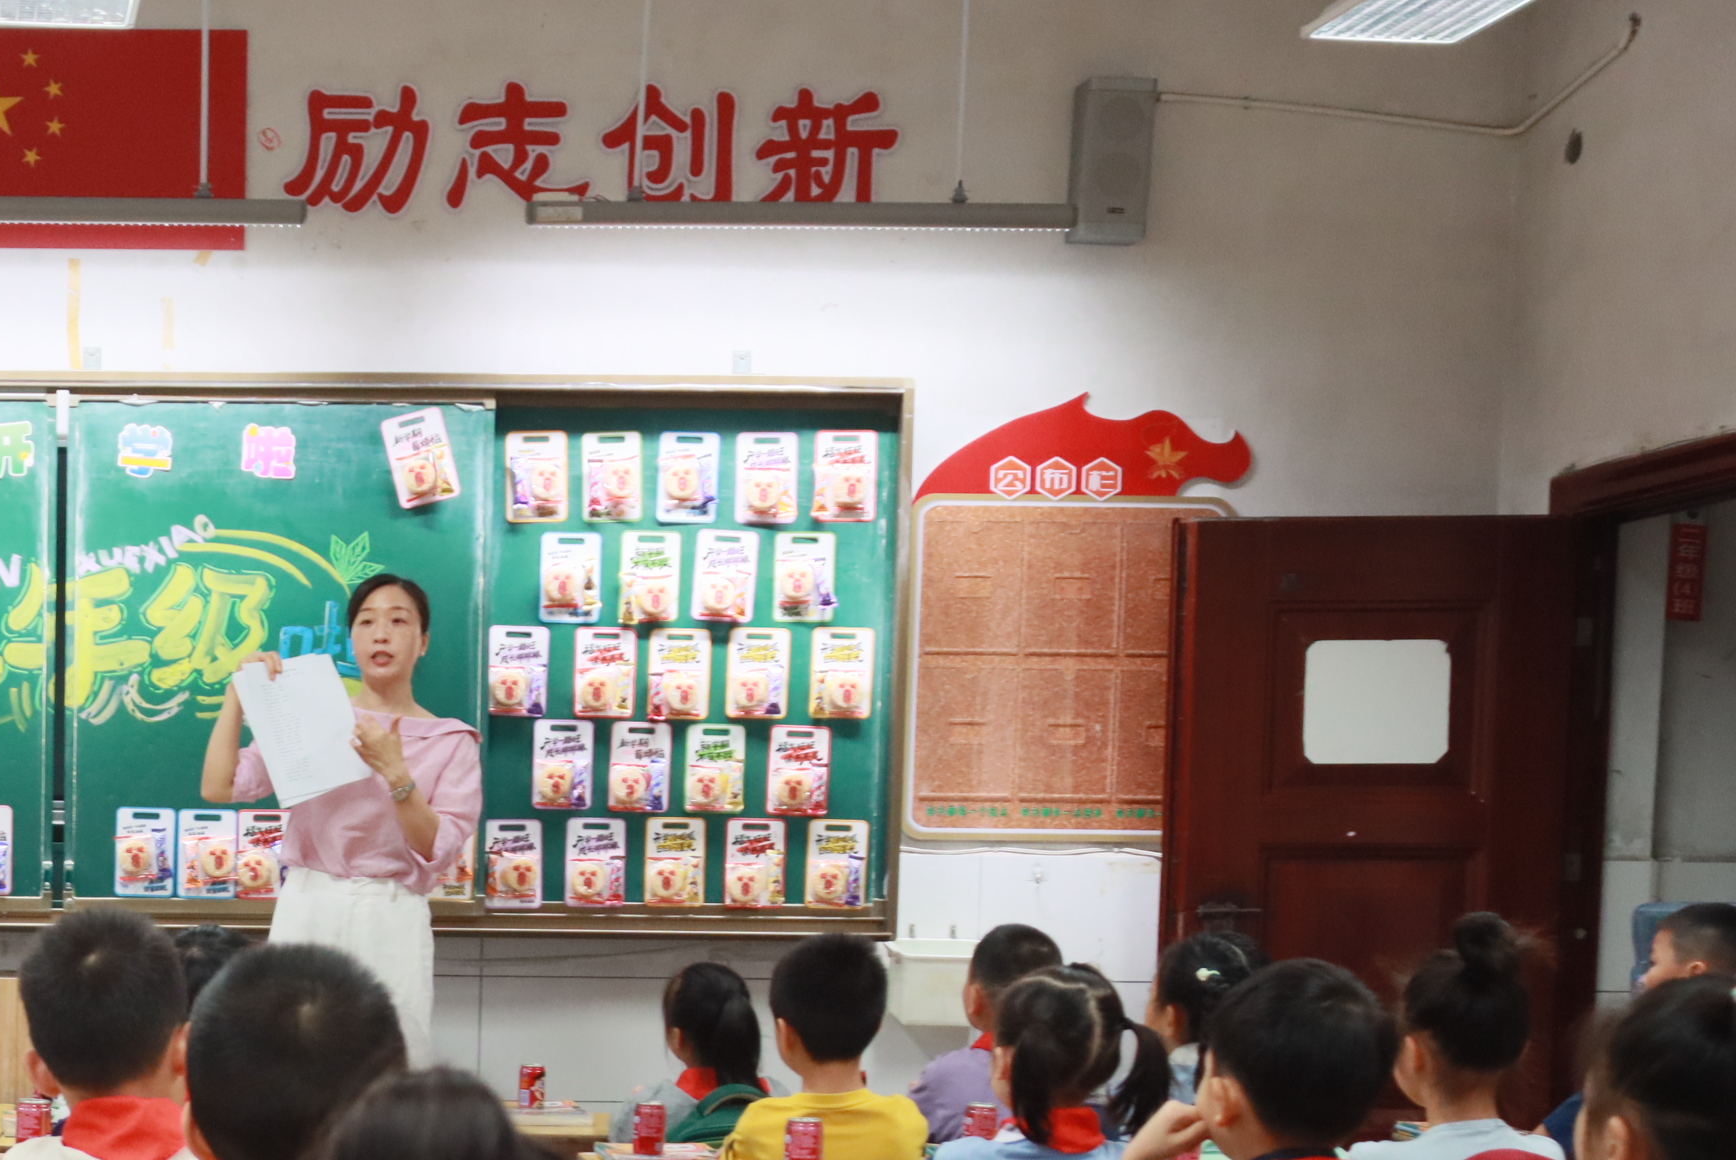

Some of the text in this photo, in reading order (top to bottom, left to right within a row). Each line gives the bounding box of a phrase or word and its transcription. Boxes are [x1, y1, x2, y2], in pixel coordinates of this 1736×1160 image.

[282, 80, 899, 215] 励志创新
[995, 468, 1118, 494] 公布栏
[77, 513, 216, 577] XUEXIAO
